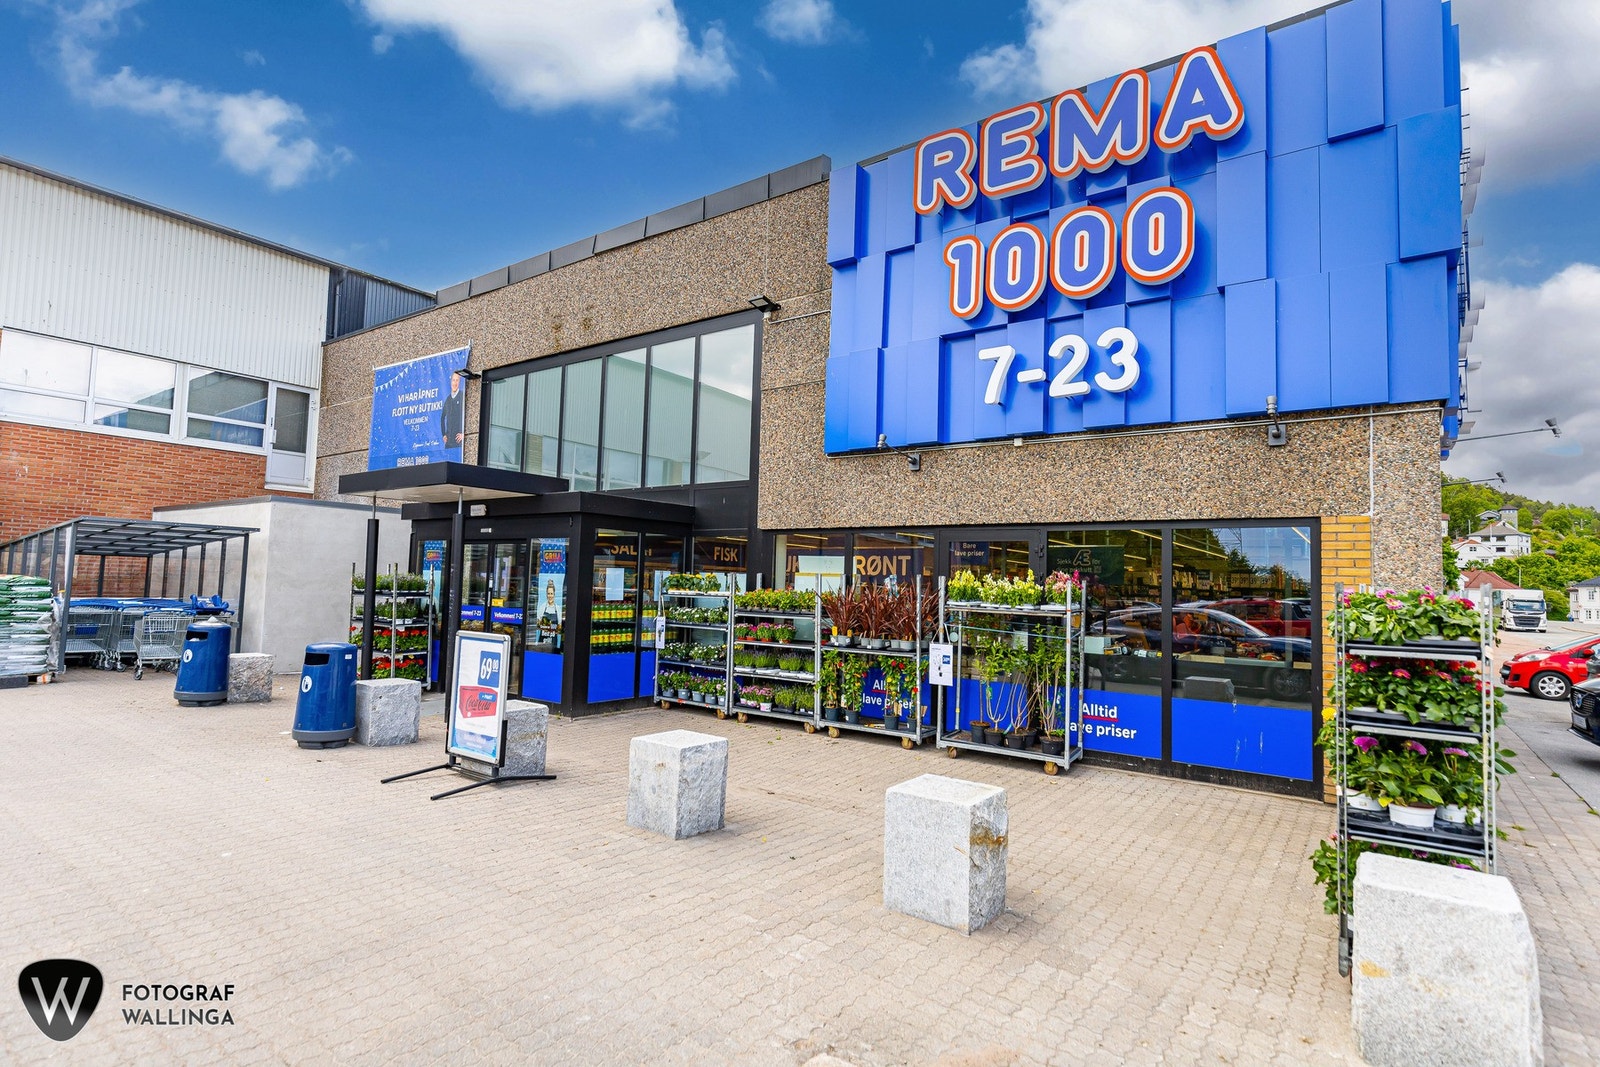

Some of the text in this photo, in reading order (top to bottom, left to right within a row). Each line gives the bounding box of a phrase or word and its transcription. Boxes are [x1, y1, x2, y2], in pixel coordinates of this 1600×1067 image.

[913, 45, 1245, 217] REMA
[943, 186, 1195, 320] 1000
[978, 327, 1140, 405] 7-23
[398, 388, 438, 403] VI HAR ÅPNET
[392, 400, 443, 417] FLOTT NY BUTIKK!
[714, 546, 738, 562] FISK
[855, 555, 911, 576] RØNT
[872, 679, 903, 692] Alli
[862, 692, 912, 710] lave pser
[1081, 702, 1118, 718] Alltid
[1069, 721, 1138, 739] ave priser
